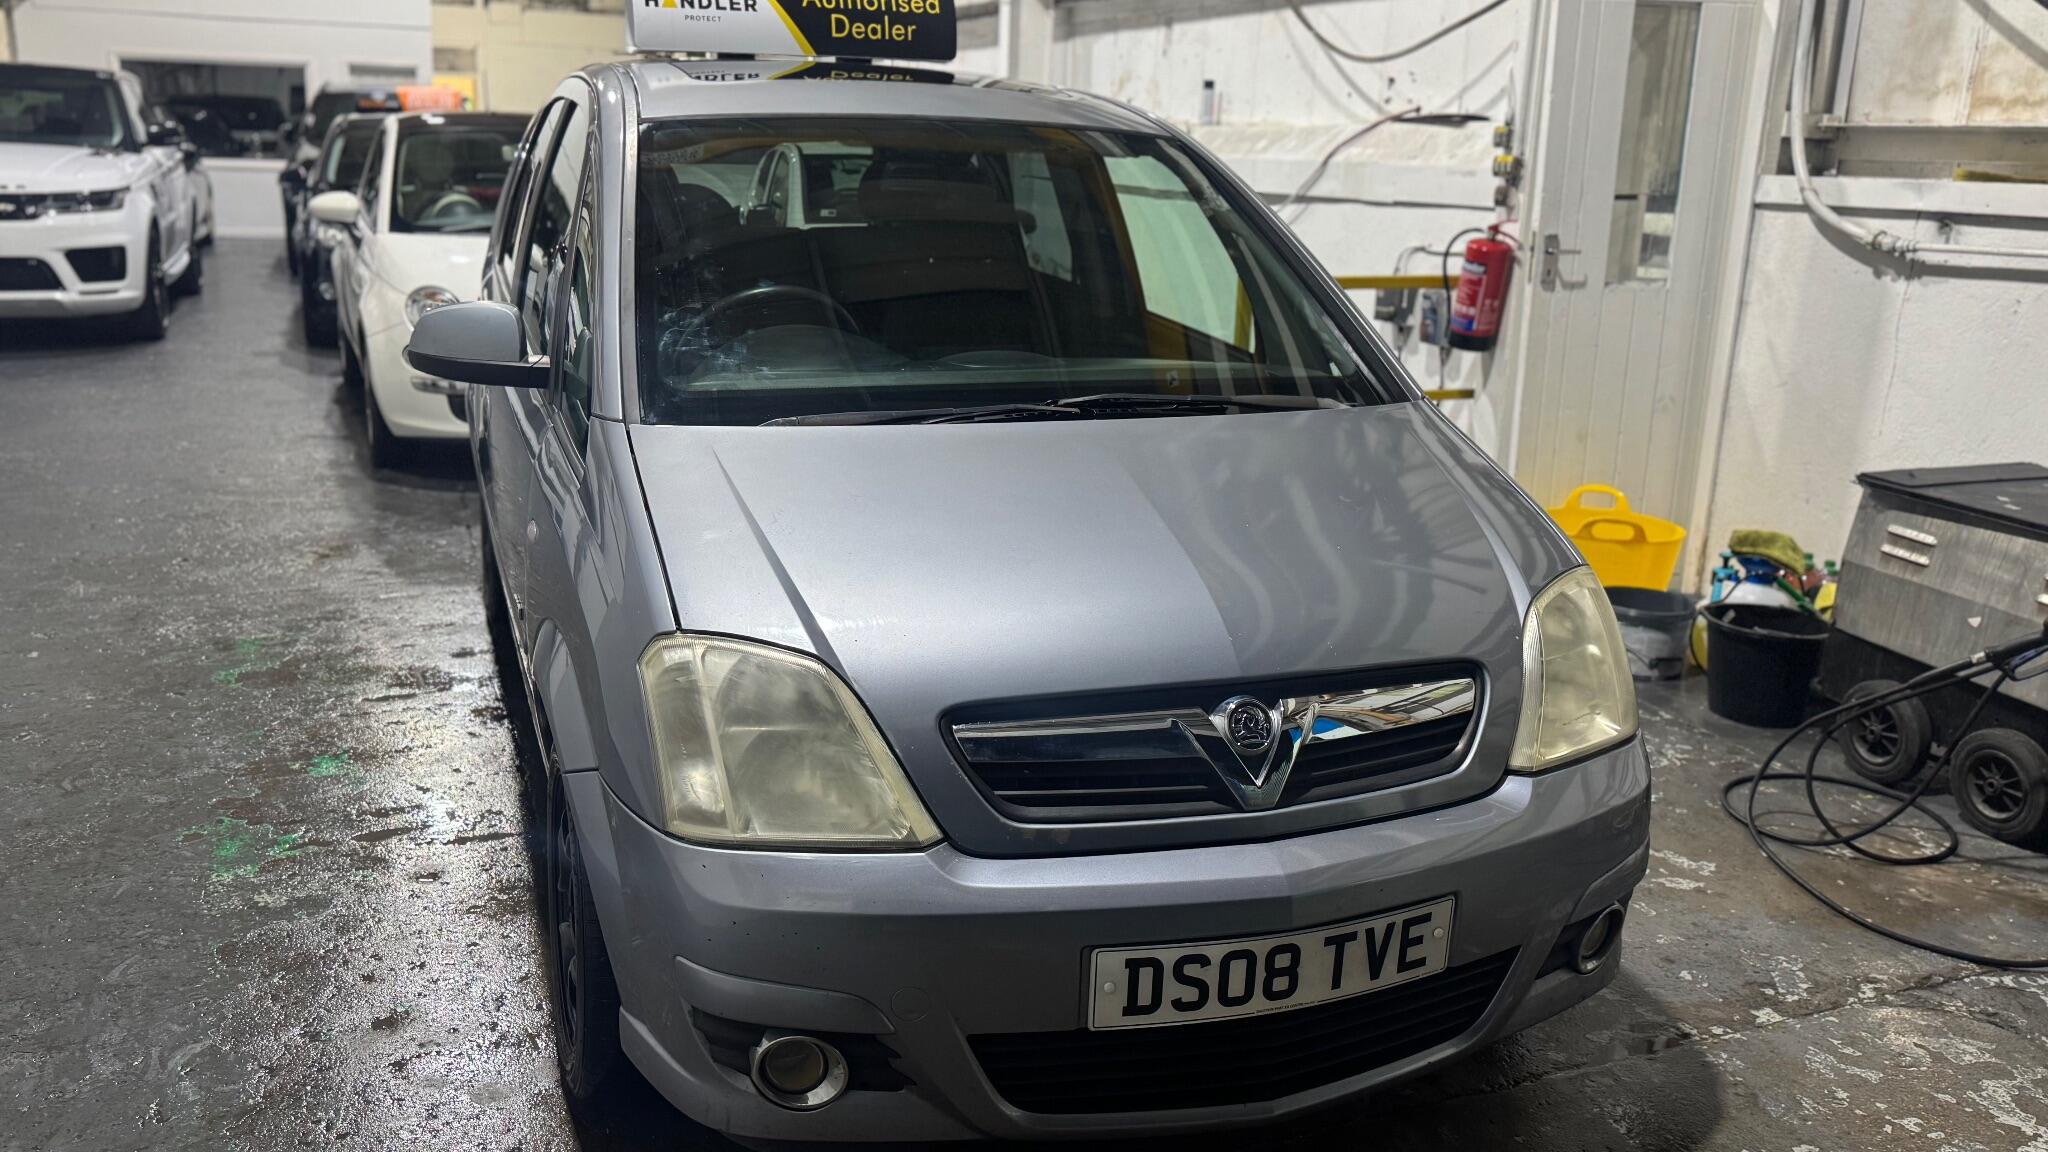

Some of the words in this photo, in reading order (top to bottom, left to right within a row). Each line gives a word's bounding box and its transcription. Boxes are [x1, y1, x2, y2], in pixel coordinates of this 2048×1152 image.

[802, 0, 940, 14] uorised
[684, 15, 722, 23] PROTECT
[831, 13, 917, 41] Dealer
[1122, 942, 1302, 1017] DS08
[1323, 911, 1433, 991] TVE
